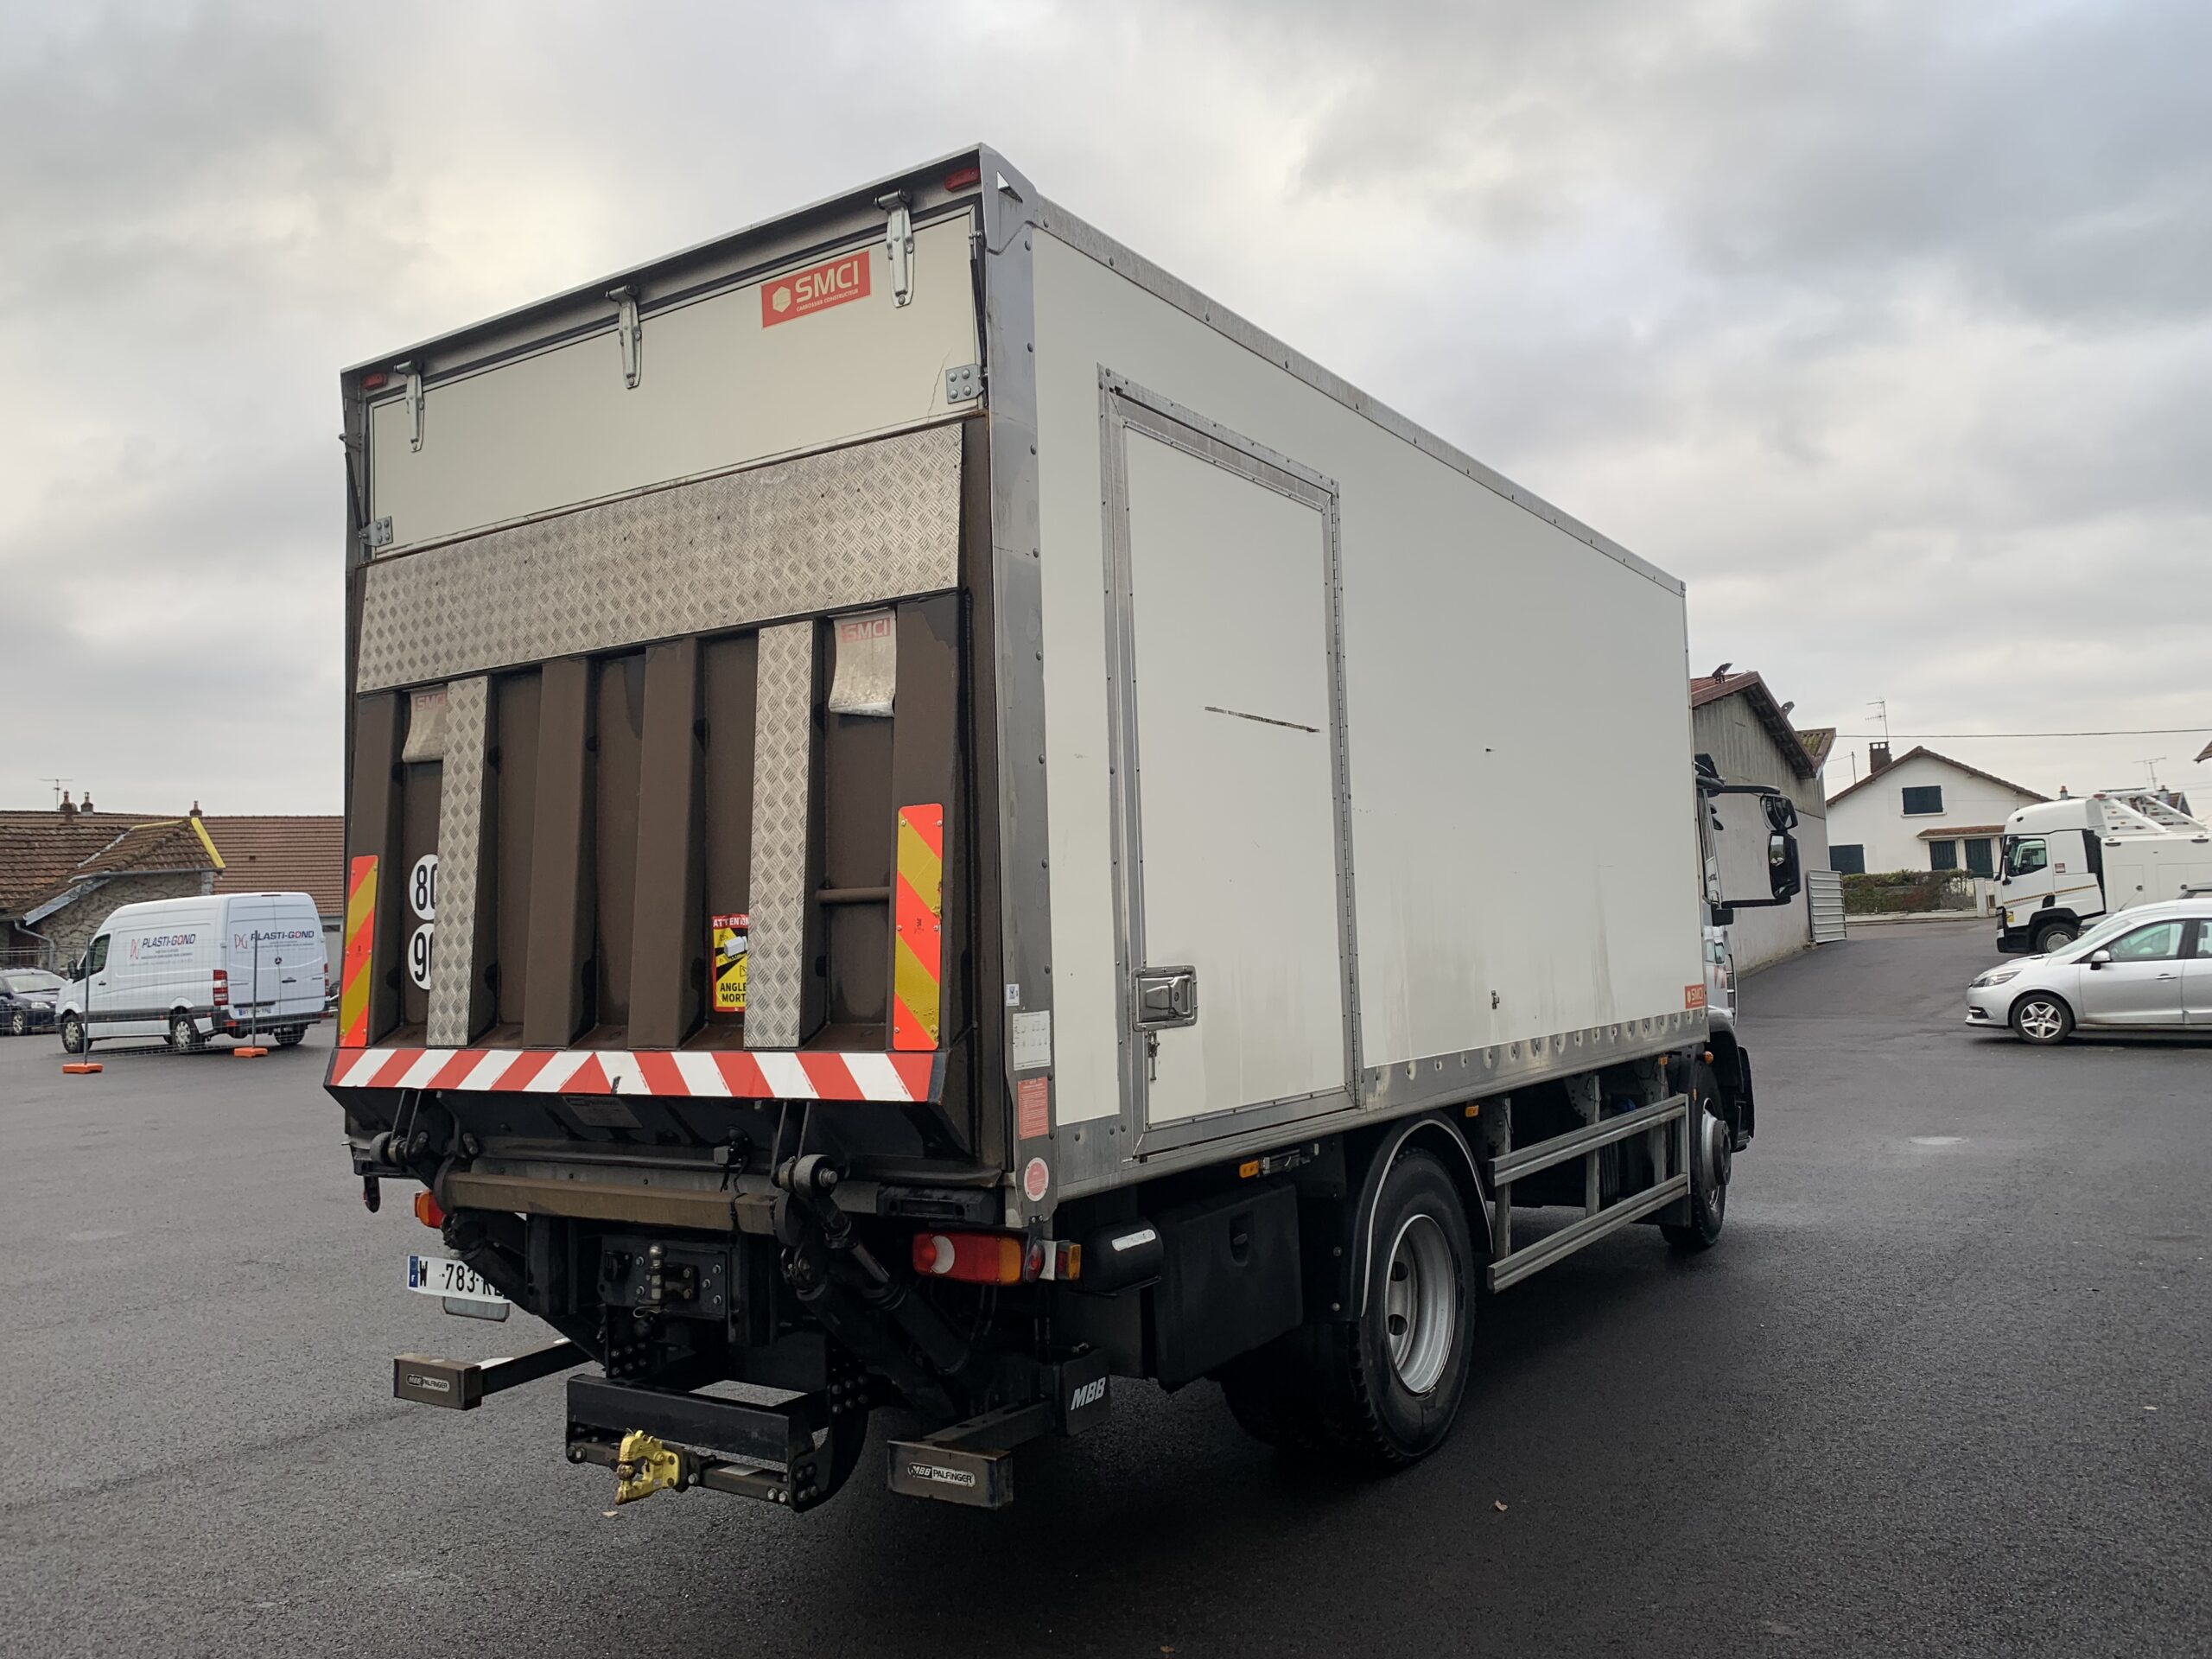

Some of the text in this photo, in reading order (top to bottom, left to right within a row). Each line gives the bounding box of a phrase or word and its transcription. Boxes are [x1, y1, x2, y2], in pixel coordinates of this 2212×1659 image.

[795, 260, 859, 303] SMCI
[844, 619, 888, 639] SMCI
[142, 933, 196, 948] PLASTI-GOND
[251, 930, 315, 941] PLASTI-GOND
[1071, 1376, 1106, 1410] MBB
[932, 1469, 973, 1484] PALFINGER
